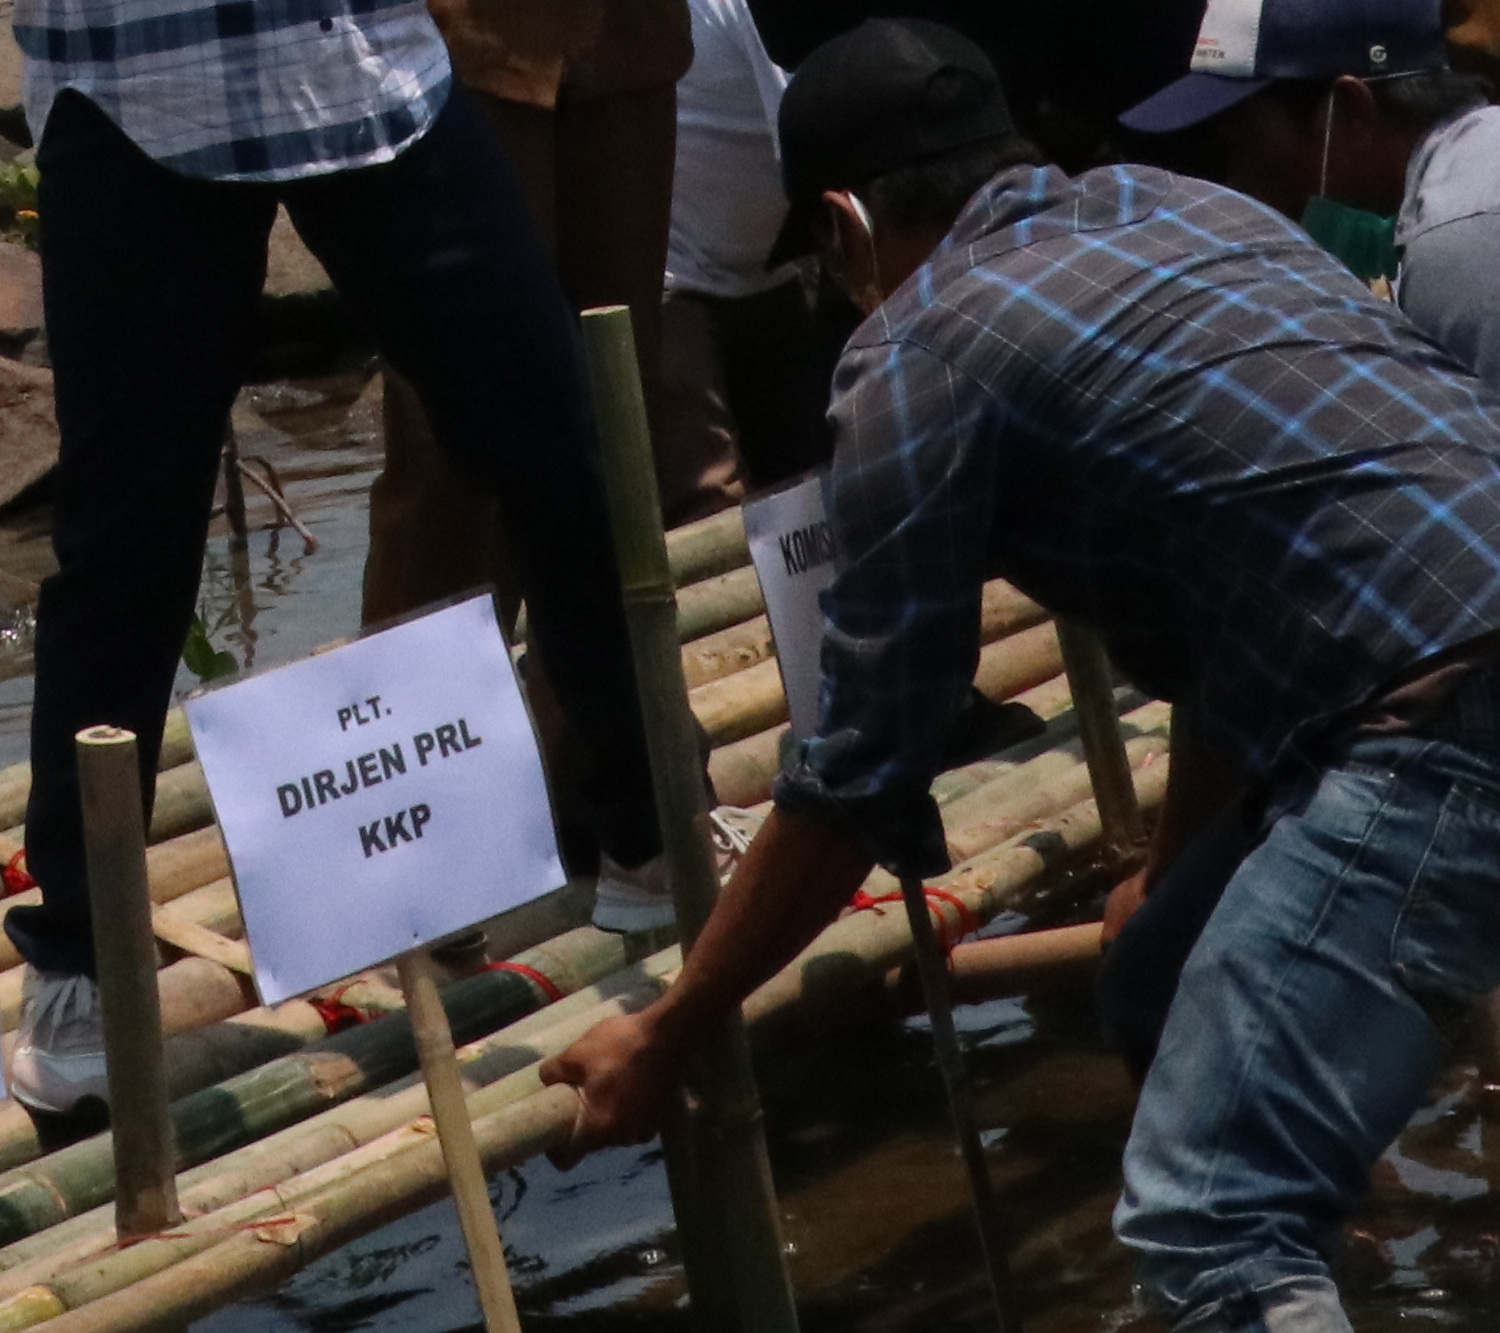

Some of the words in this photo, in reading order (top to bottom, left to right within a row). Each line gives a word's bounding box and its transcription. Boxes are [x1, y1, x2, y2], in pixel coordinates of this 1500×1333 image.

[337, 694, 393, 731] PLT.
[276, 744, 407, 817] DIRJEN
[413, 719, 482, 766] PRL
[358, 803, 433, 859] KKP
